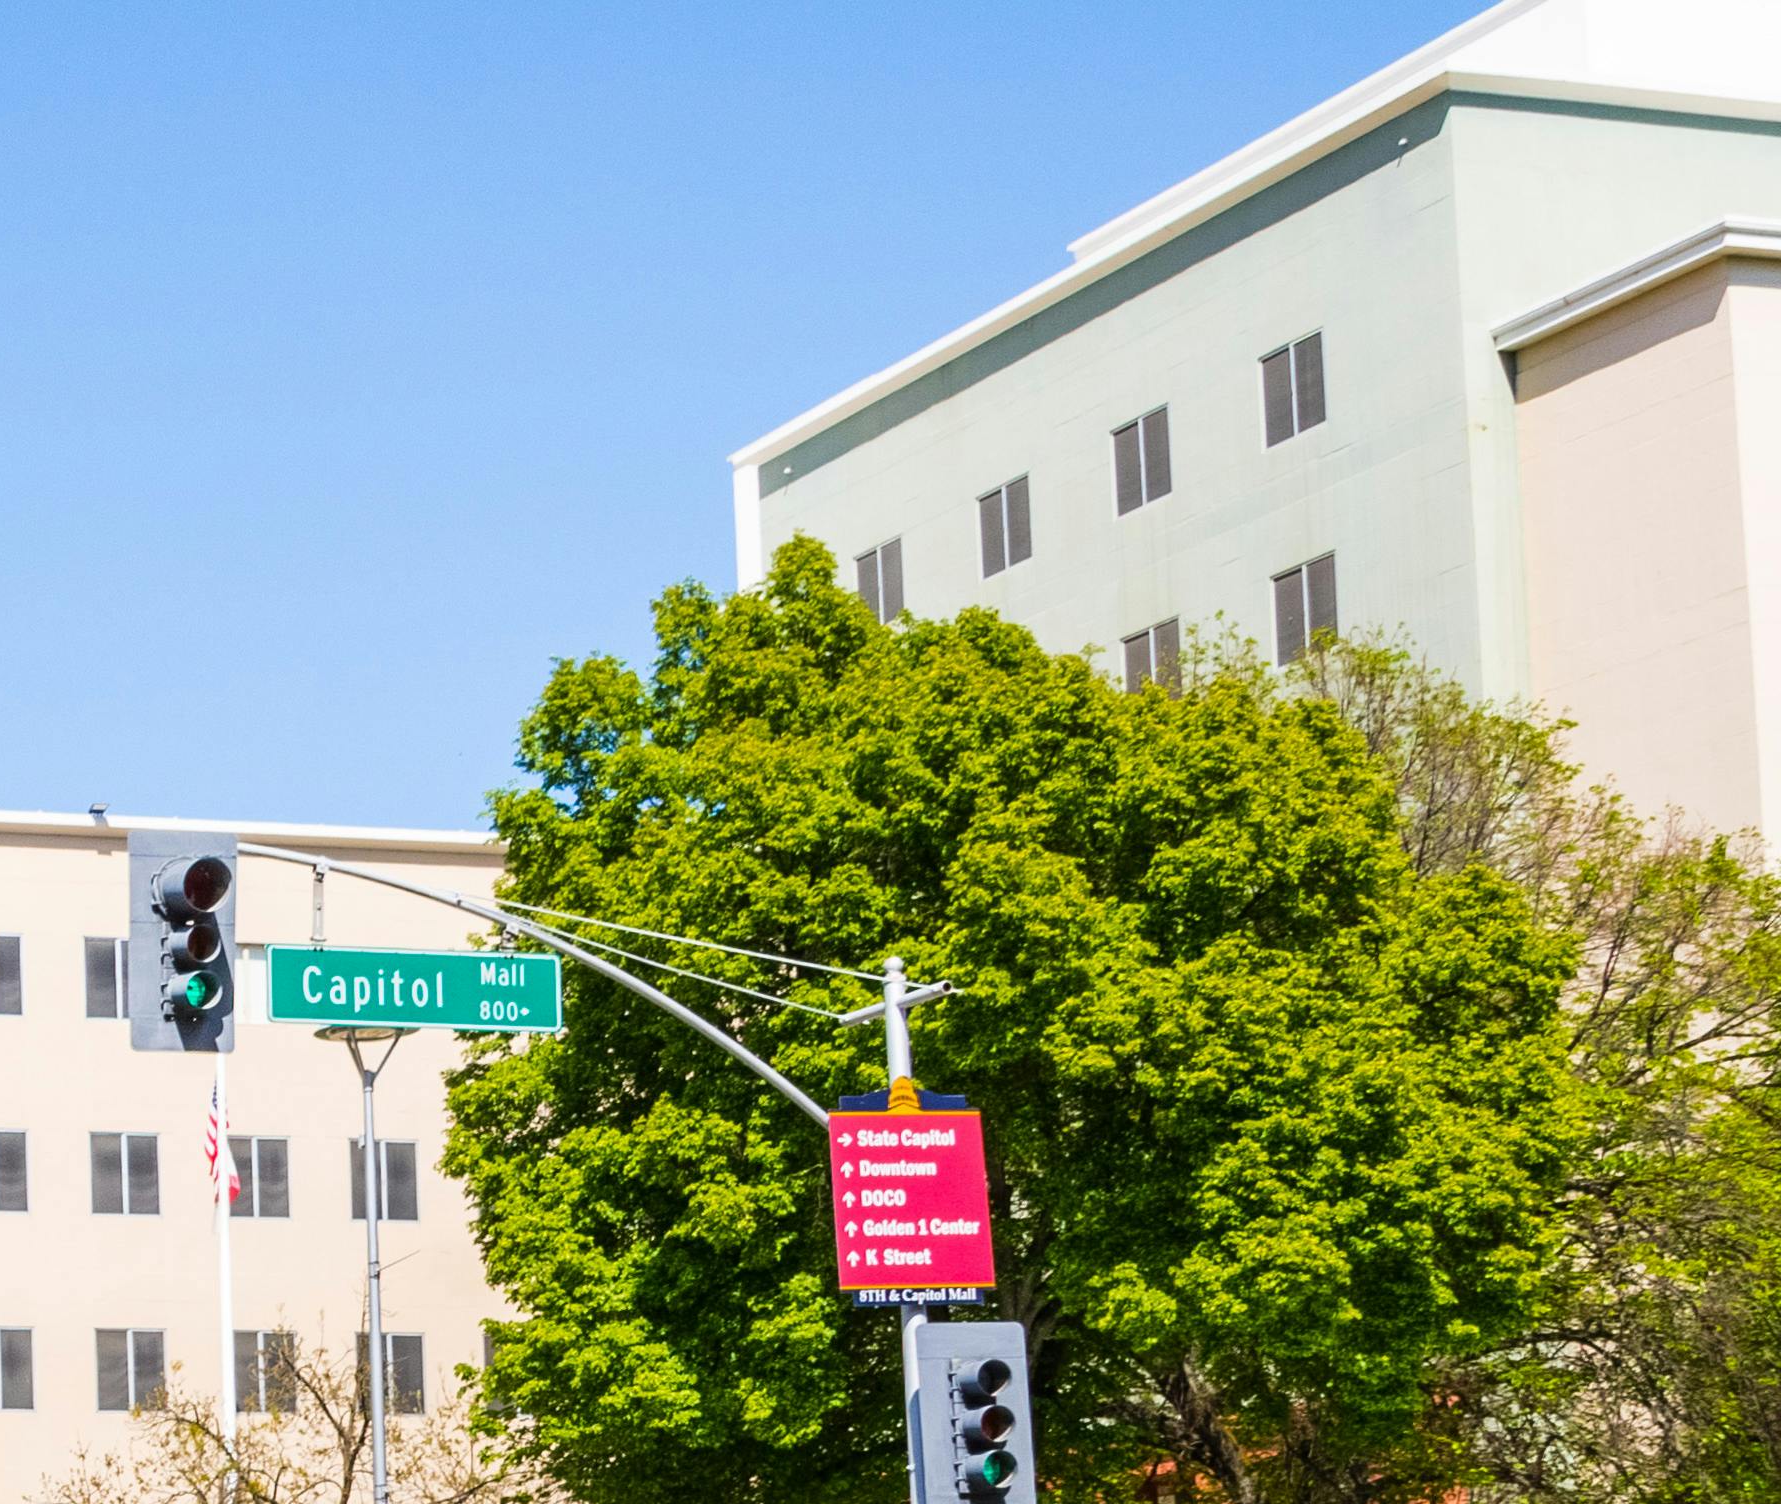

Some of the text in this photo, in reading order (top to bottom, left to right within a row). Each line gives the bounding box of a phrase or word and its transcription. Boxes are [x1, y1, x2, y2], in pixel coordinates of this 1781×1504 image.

[302, 961, 525, 1013] Capitol Mall
[479, 1000, 518, 1021] 800
[857, 1128, 956, 1149] State Capitol
[859, 1160, 937, 1177] Downtown
[861, 1189, 907, 1207] DOCO
[862, 1217, 980, 1236] Golden 1 Center
[865, 1247, 932, 1266] K Street
[859, 1288, 977, 1305] 8TH & Capitol Mall
